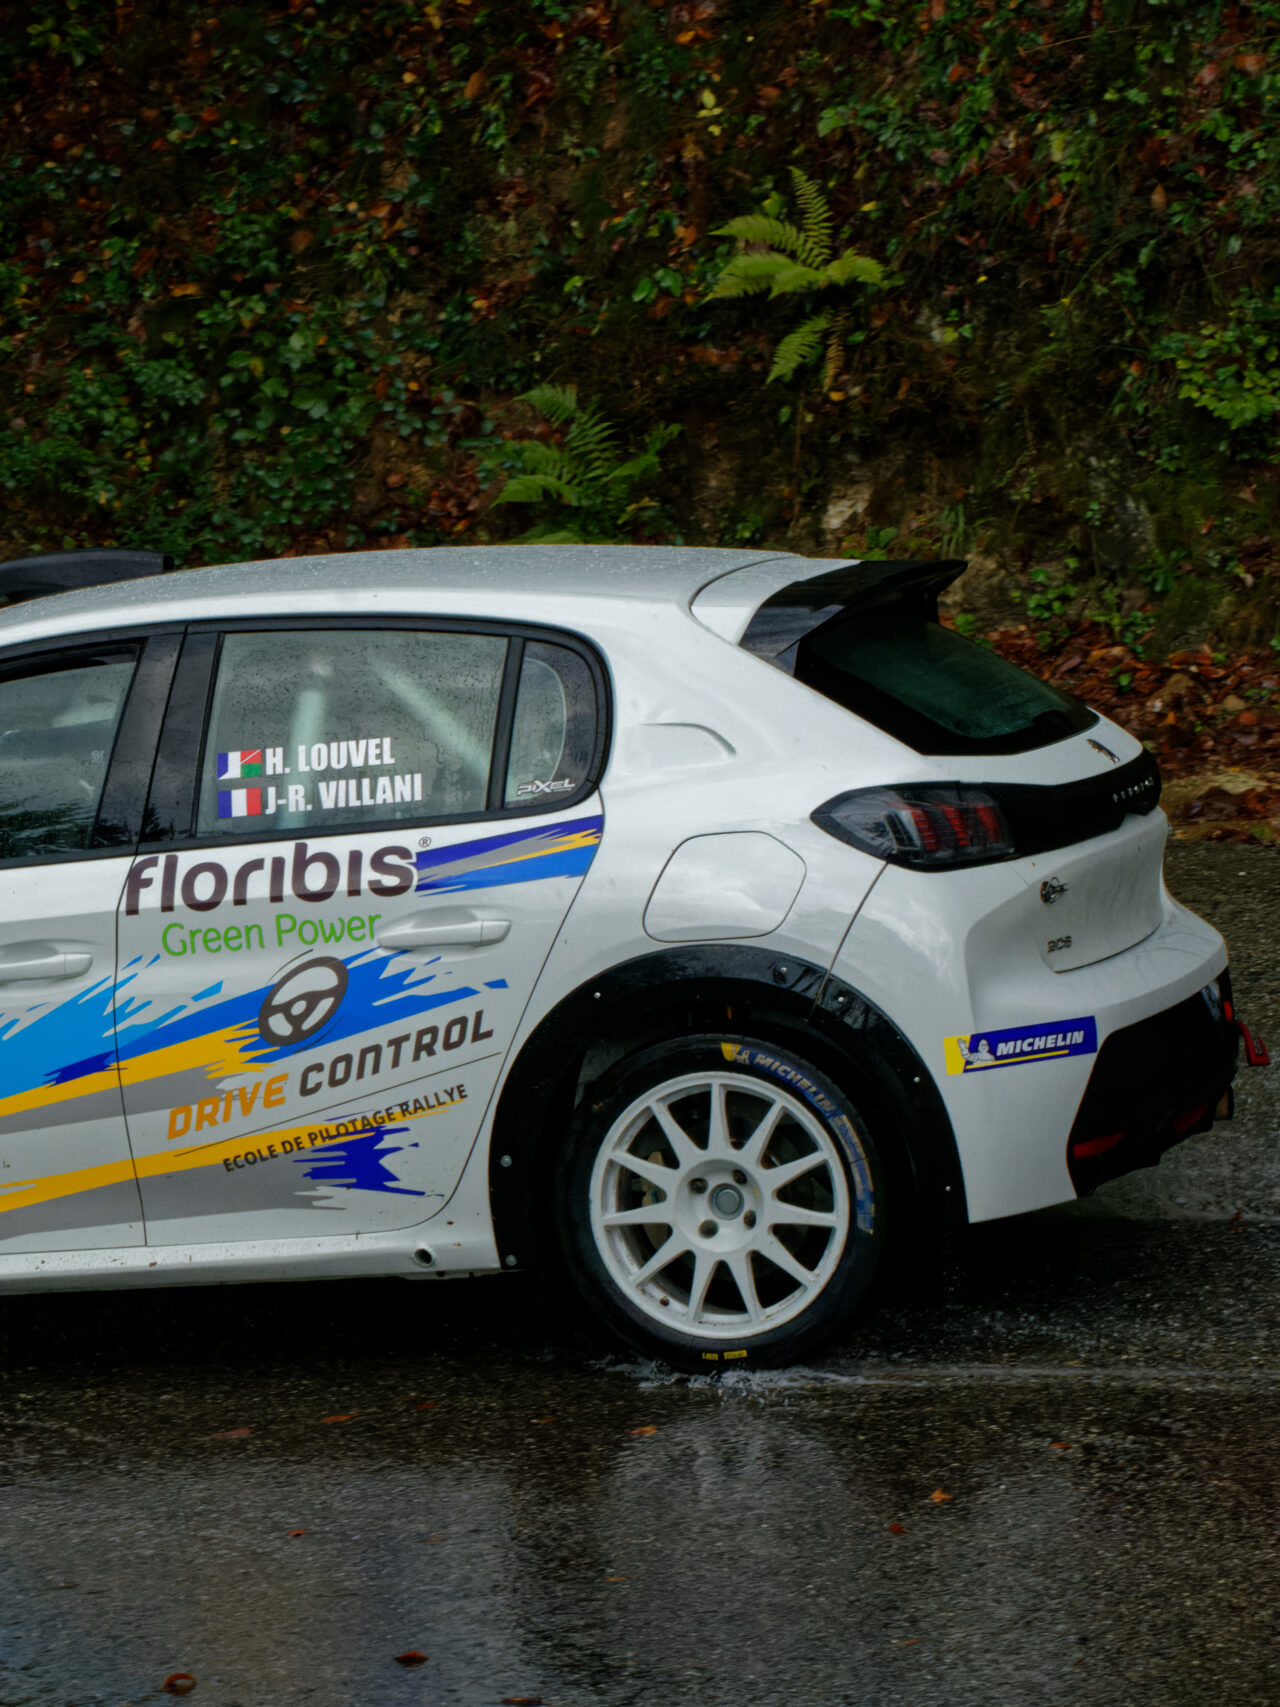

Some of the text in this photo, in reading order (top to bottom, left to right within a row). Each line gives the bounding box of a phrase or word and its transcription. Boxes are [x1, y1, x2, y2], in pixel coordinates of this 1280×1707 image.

[265, 737, 395, 775] H. LOUVEL
[265, 773, 423, 815] J-R. VILLANI
[161, 913, 382, 957] Green Power
[997, 1030, 1084, 1057] MICHELIN
[167, 1009, 495, 1140] DRIVE CONTROL
[223, 1083, 469, 1173] ECOLE DE PILOTAGE RALLYE
